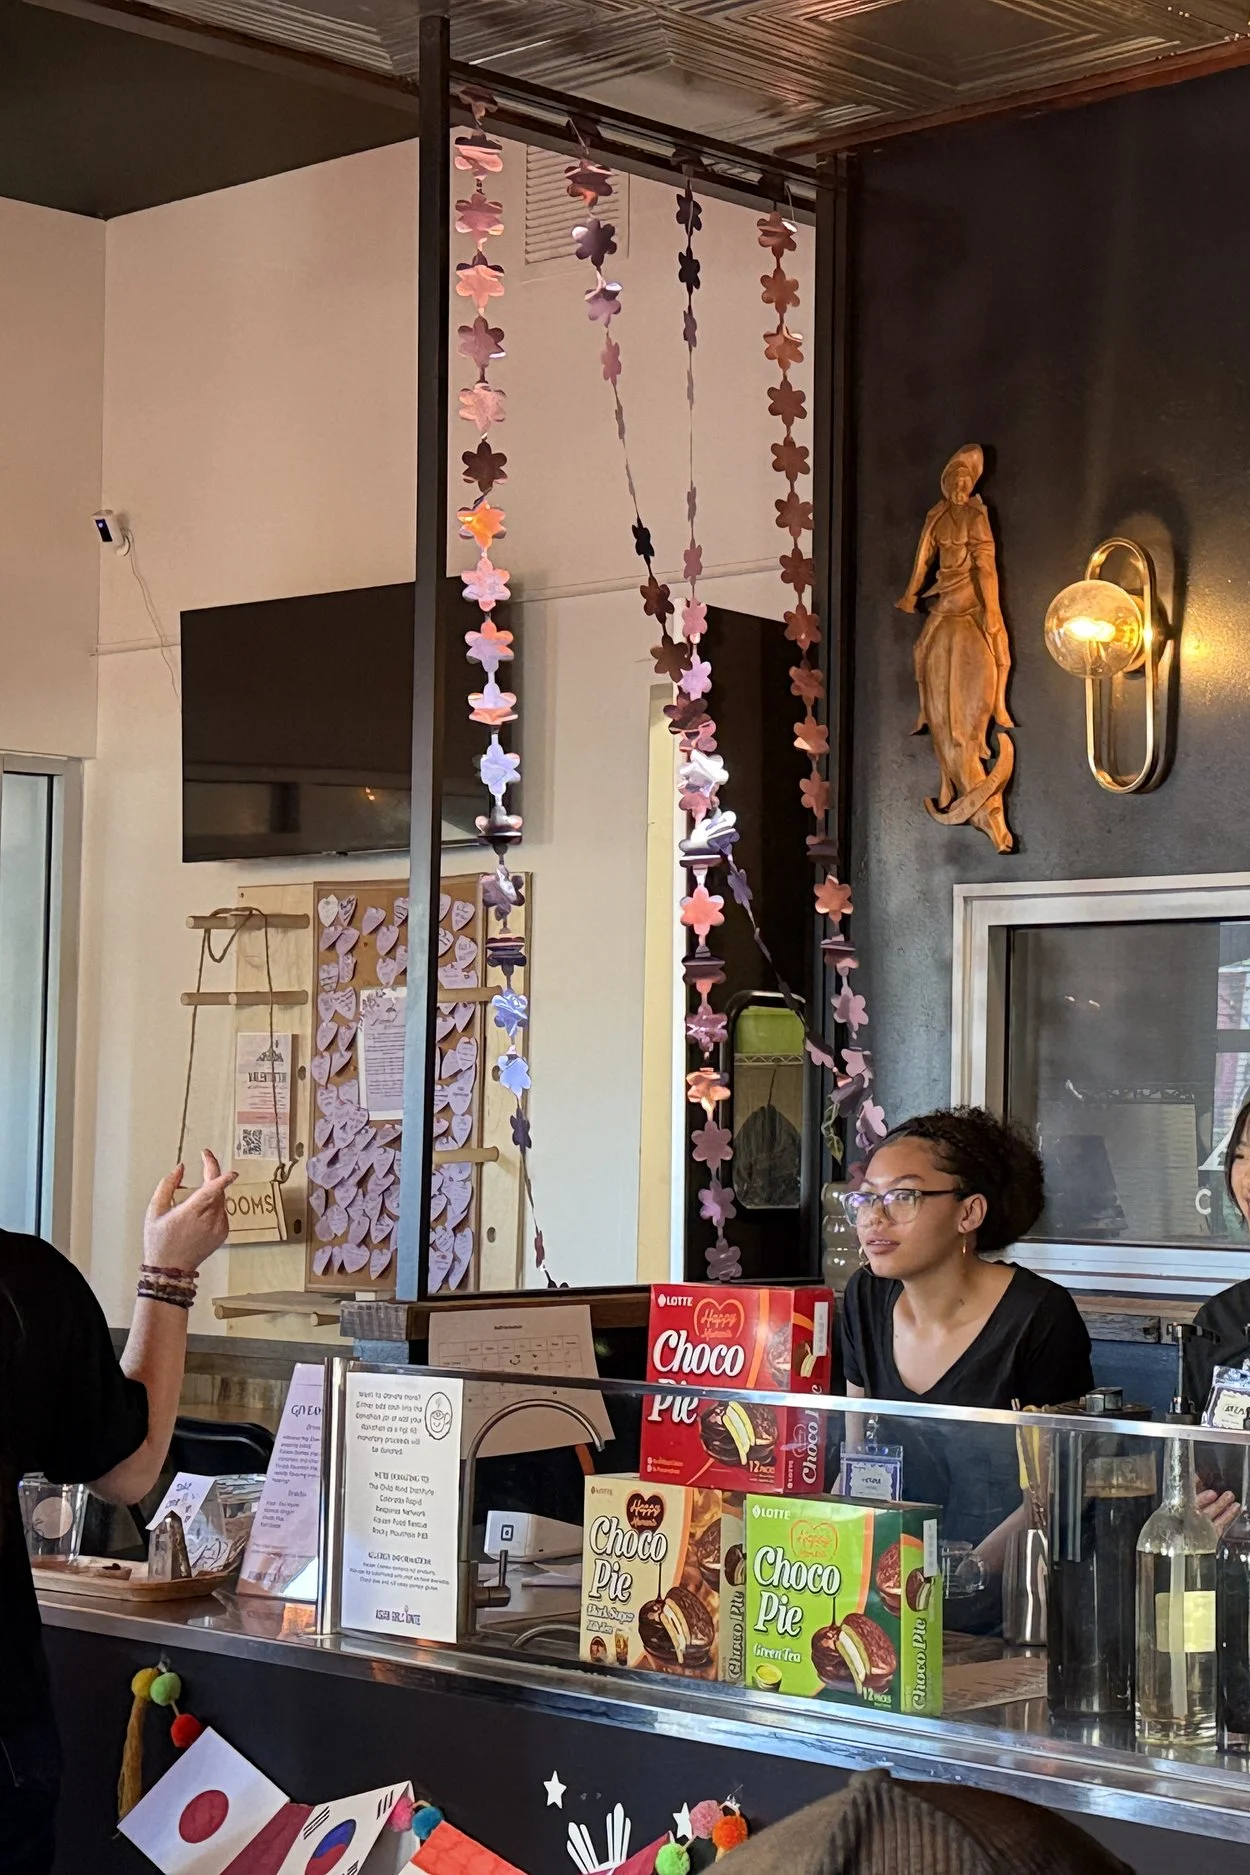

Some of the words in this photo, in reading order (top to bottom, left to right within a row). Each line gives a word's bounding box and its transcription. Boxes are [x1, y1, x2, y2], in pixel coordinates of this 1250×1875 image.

[667, 1296, 693, 1307] LOTTE
[700, 1309, 737, 1328] Happy
[653, 1329, 745, 1377] Choco
[749, 1460, 760, 1473] 12
[802, 1422, 820, 1485] Choco
[629, 1499, 661, 1517] Happy
[761, 1507, 791, 1520] LOTTE
[589, 1515, 668, 1561] Choco
[589, 1558, 633, 1602] Pie
[753, 1545, 841, 1596] Choco
[753, 1590, 803, 1638] Pie
[912, 1617, 927, 1650] Pie
[753, 1642, 784, 1661] Green
[784, 1648, 801, 1663] Tea
[862, 1686, 874, 1701] 12
[912, 1651, 927, 1711] Choco
